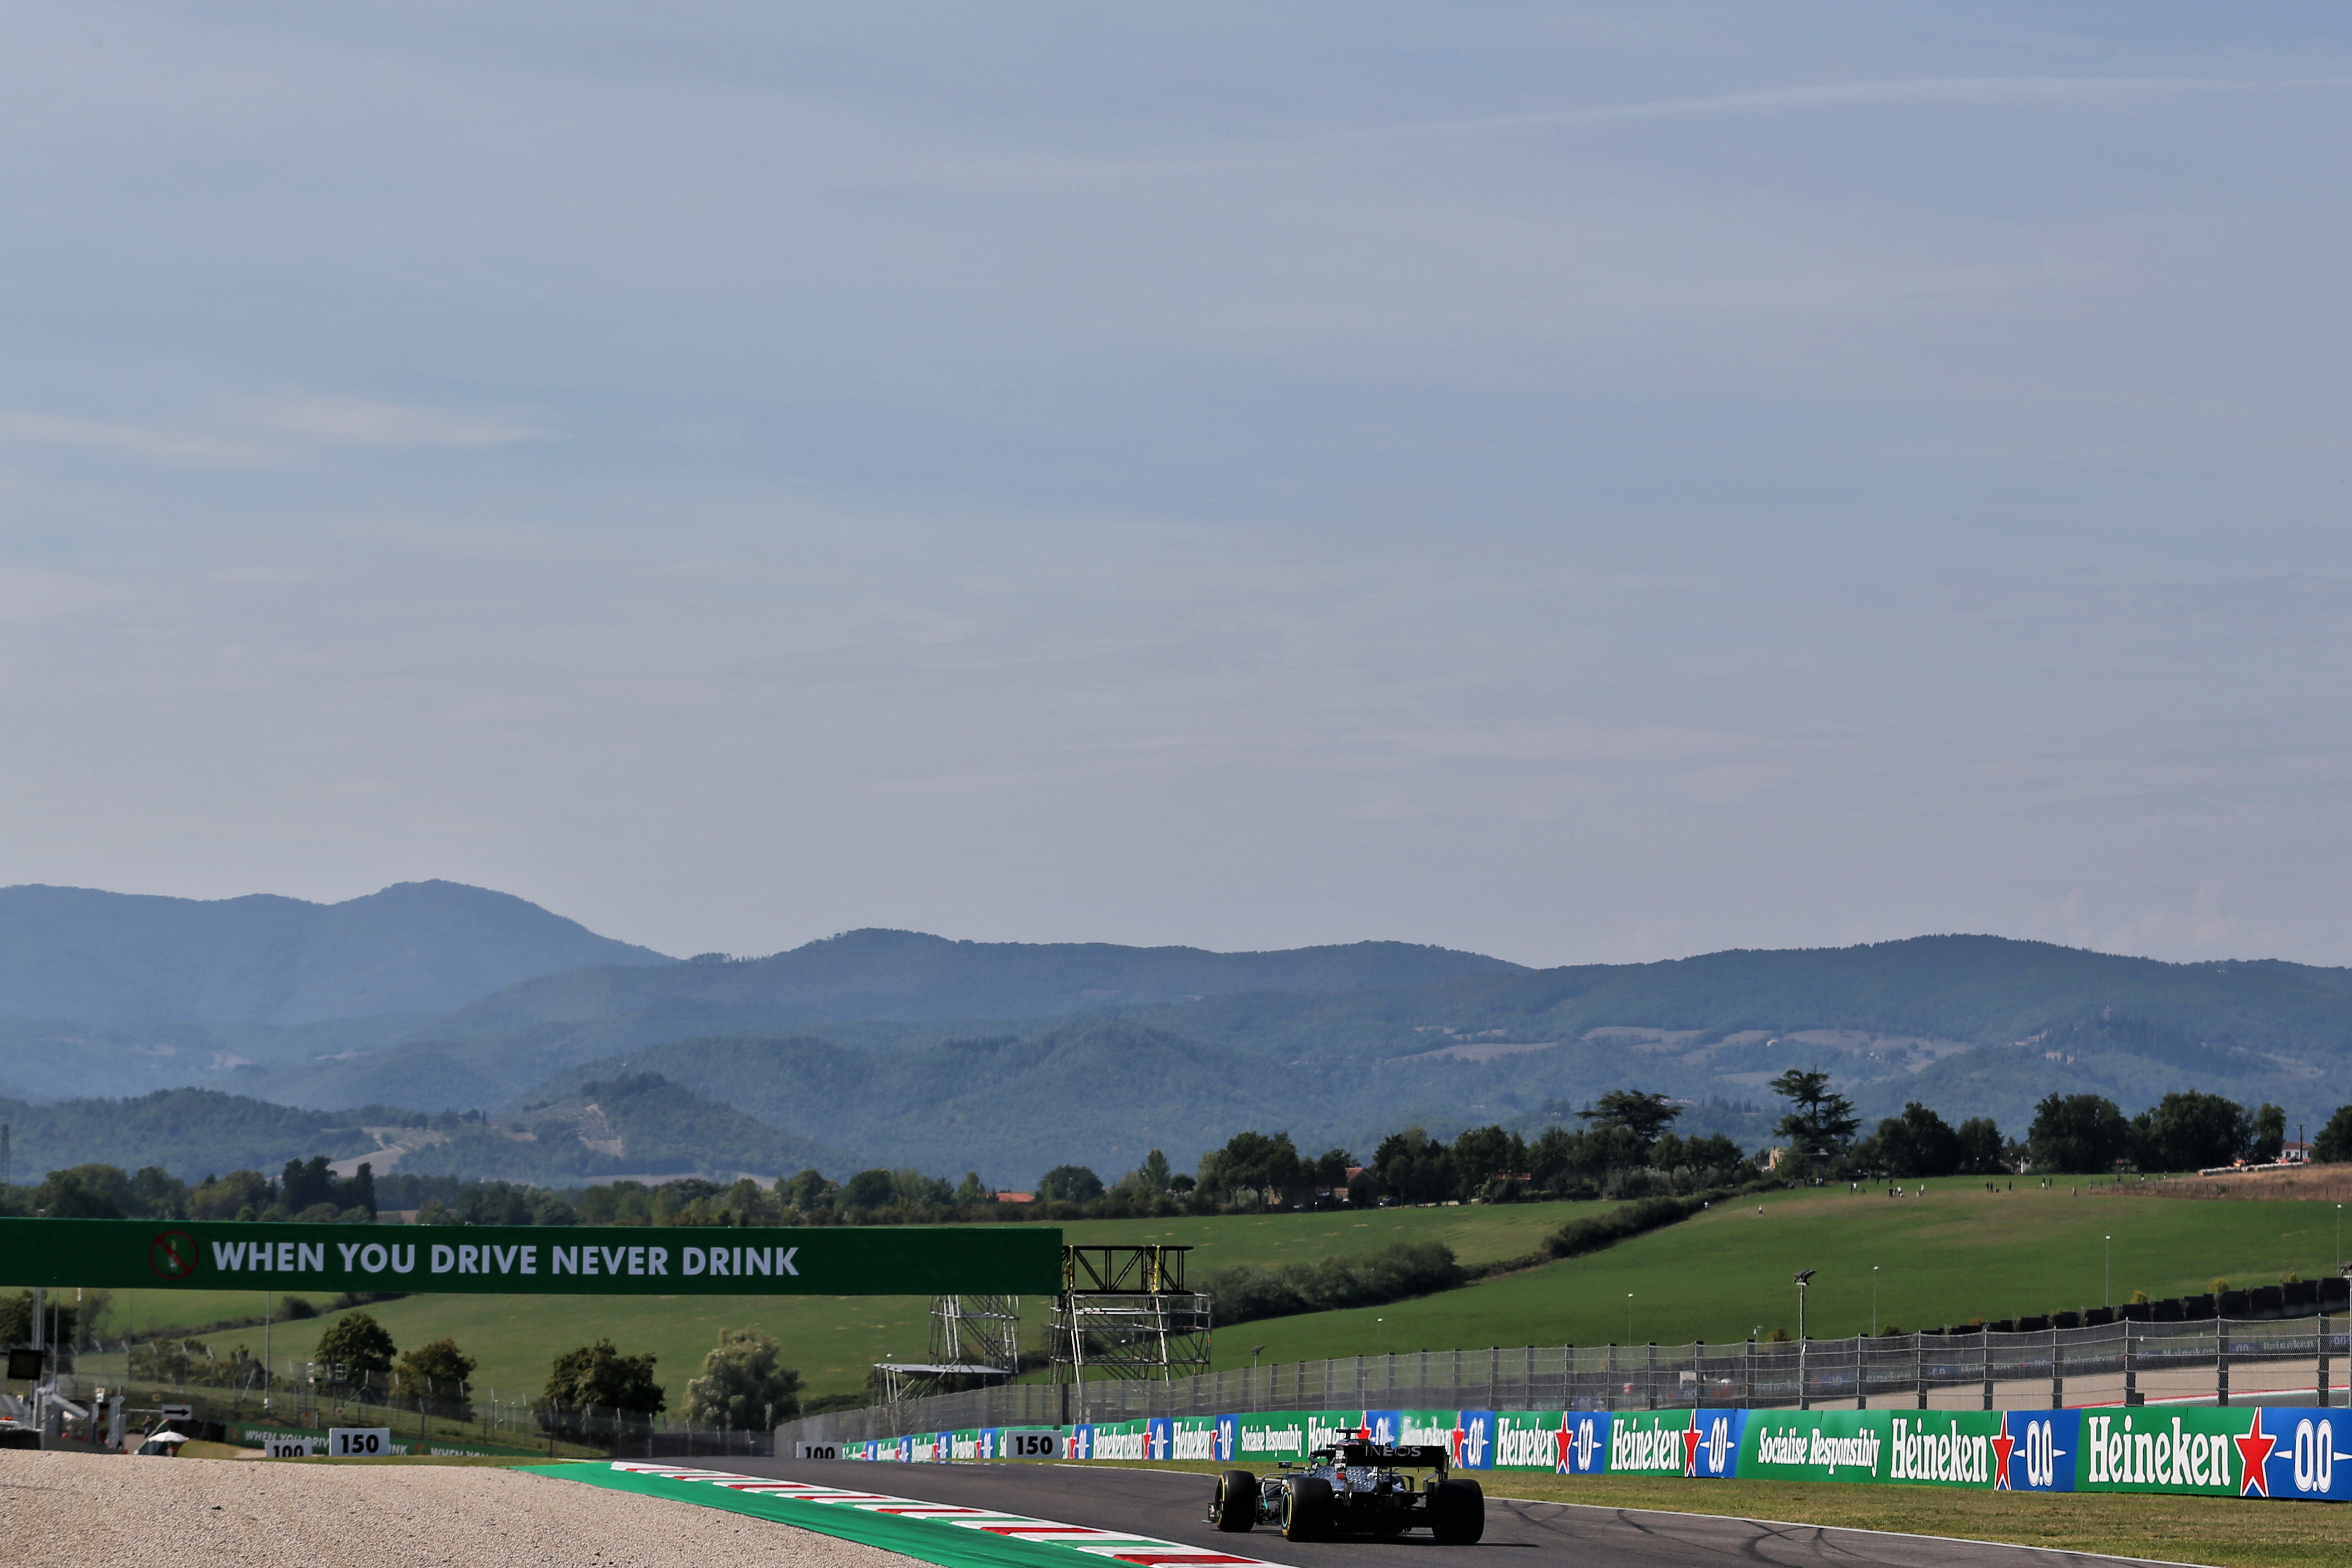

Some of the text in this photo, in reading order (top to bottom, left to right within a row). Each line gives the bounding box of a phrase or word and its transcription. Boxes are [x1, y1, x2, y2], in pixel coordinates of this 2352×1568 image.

[212, 1241, 799, 1276] WHEN YOU DRIVE NEVER DRINK
[245, 1430, 277, 1441] WHEN
[341, 1434, 379, 1453] 150
[1016, 1436, 1053, 1455] 150
[1172, 1421, 1210, 1460] Heineken
[1610, 1416, 1680, 1470] Heineken
[274, 1445, 304, 1457] 100
[805, 1446, 836, 1460] 100
[1364, 1446, 1421, 1457] INEOS
[1758, 1426, 1881, 1477] Socialise Responsibly
[1890, 1418, 2053, 1487] Heineken 0.0
[2088, 1414, 2332, 1493] Heineken 0.0
